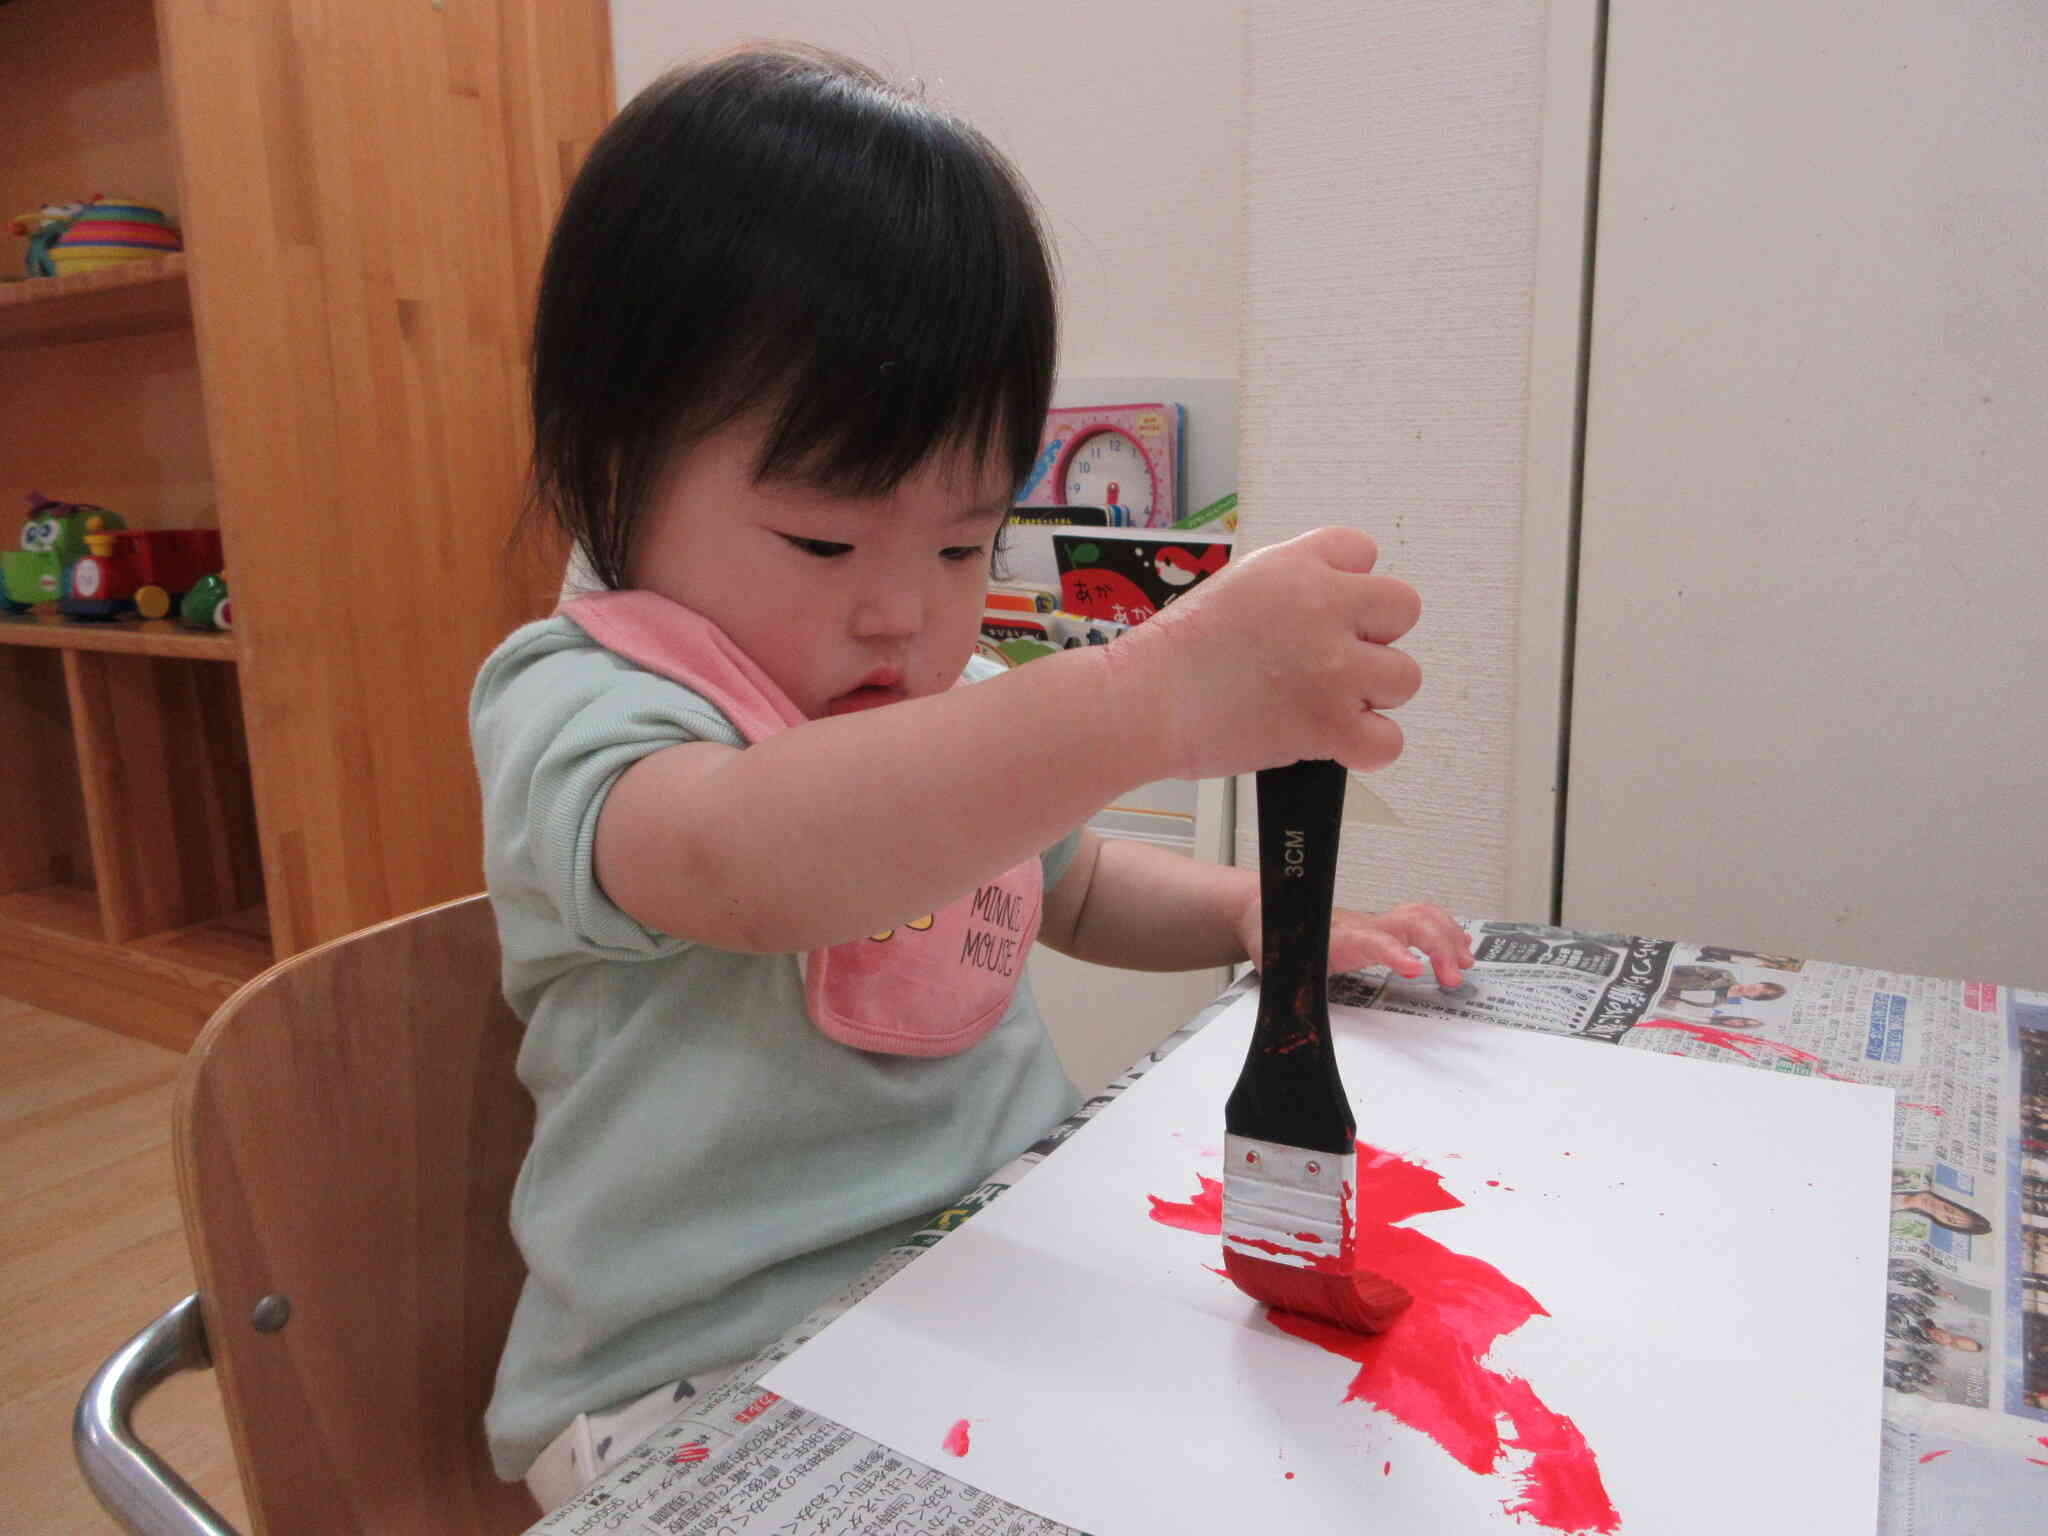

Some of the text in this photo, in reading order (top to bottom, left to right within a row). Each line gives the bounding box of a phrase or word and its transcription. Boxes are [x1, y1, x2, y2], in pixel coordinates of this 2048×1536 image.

[1110, 440, 1121, 452] 12
[1080, 461, 1090, 473] 10
[1072, 482, 1081, 494] 9
[1073, 580, 1113, 604] あか
[1112, 603, 1152, 625] あか
[1284, 830, 1305, 878] 3CM
